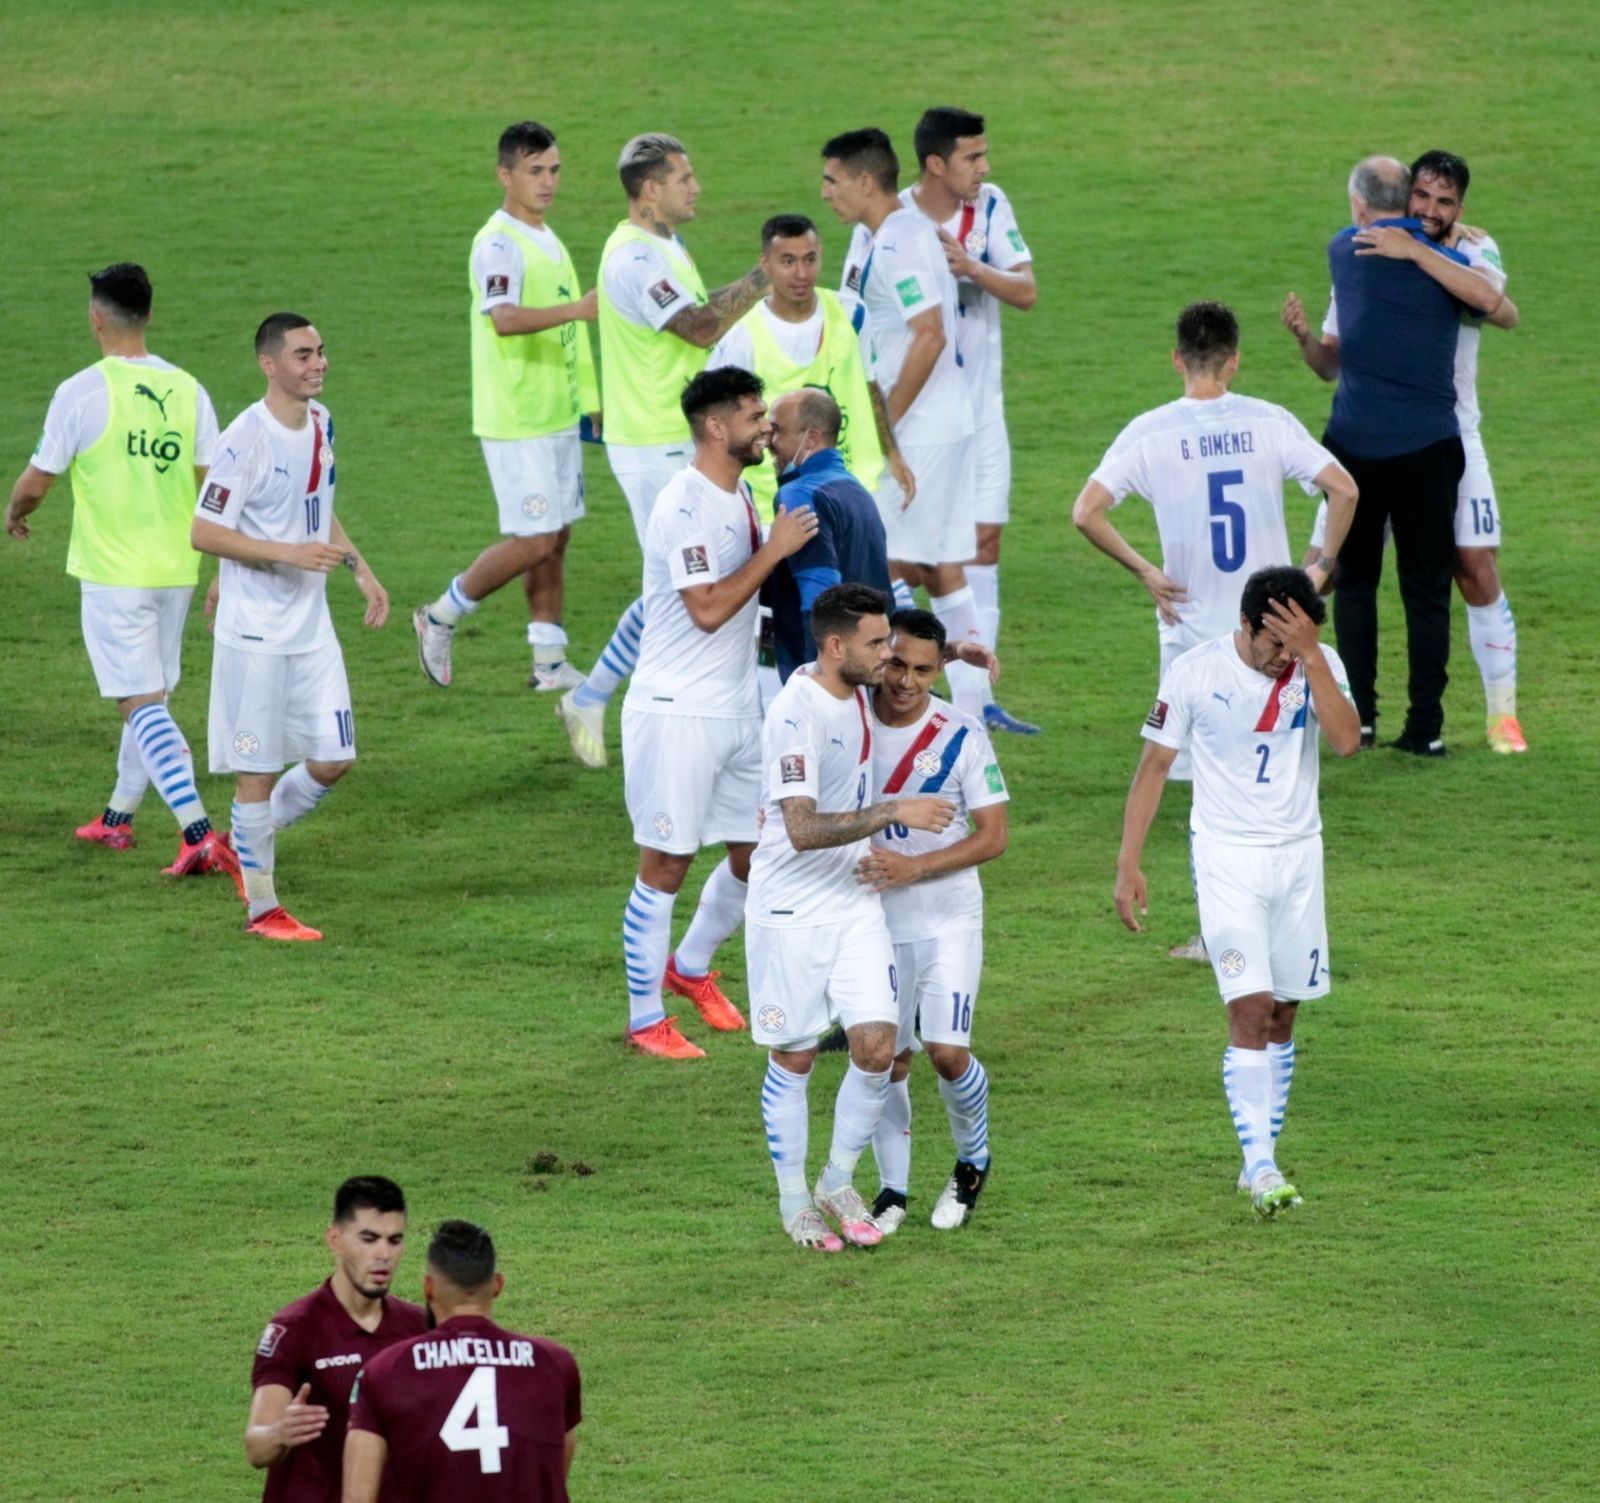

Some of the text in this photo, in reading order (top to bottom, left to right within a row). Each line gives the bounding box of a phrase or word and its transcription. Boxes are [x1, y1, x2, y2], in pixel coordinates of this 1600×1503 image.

[127, 429, 182, 474] tigo
[1200, 430, 1255, 457] GIMÉNEZ
[304, 495, 320, 536] 10
[1207, 469, 1247, 573] 5
[1470, 498, 1495, 535] 13
[334, 709, 353, 748] 10
[1255, 743, 1271, 784] 2
[856, 772, 866, 811] 9
[888, 964, 898, 1003] 9
[1307, 948, 1319, 987] 2
[951, 991, 970, 1033] 16
[412, 1337, 535, 1370] CHANCELLOR
[438, 1365, 509, 1474] 4
